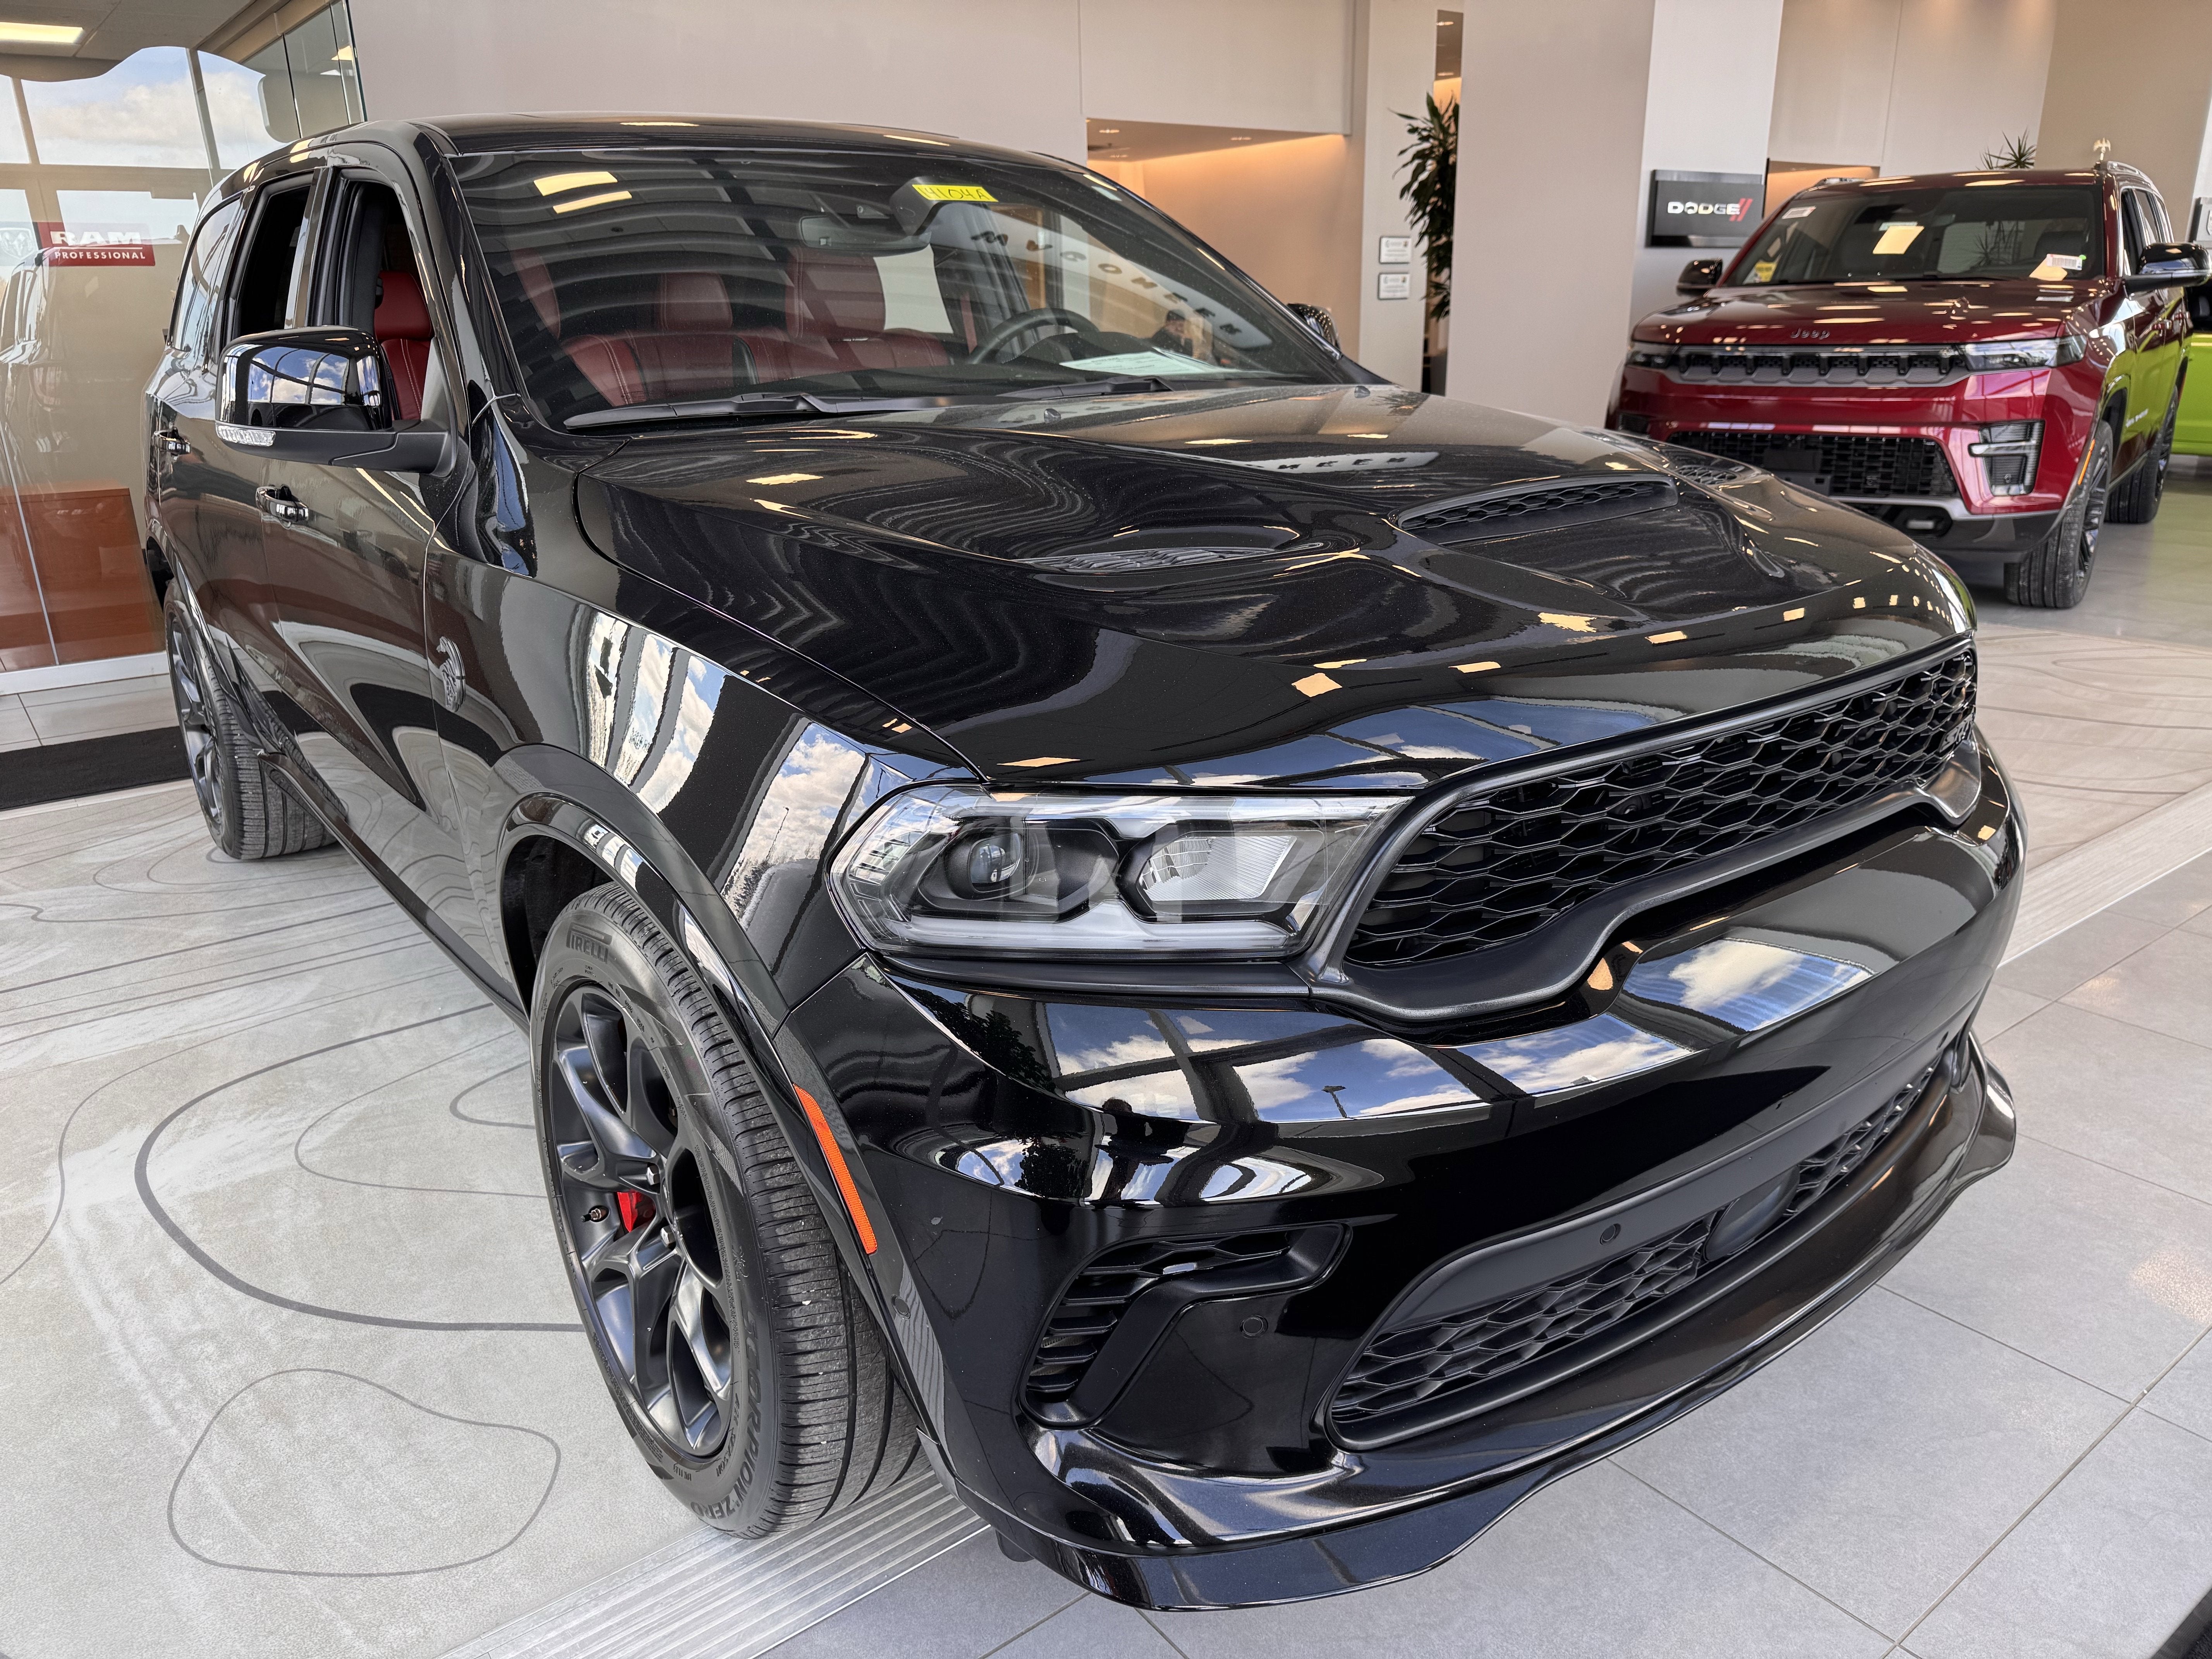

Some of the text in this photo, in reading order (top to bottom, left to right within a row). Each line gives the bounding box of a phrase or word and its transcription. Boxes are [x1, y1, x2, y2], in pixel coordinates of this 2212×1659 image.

[1668, 201, 1740, 215] DODGE
[50, 231, 142, 246] RAM
[55, 251, 146, 259] PROFESSIONAL
[1791, 328, 1830, 340] Jeep
[566, 922, 613, 964] PIRELLI
[690, 1300, 762, 1519] SCORPION ZERO
